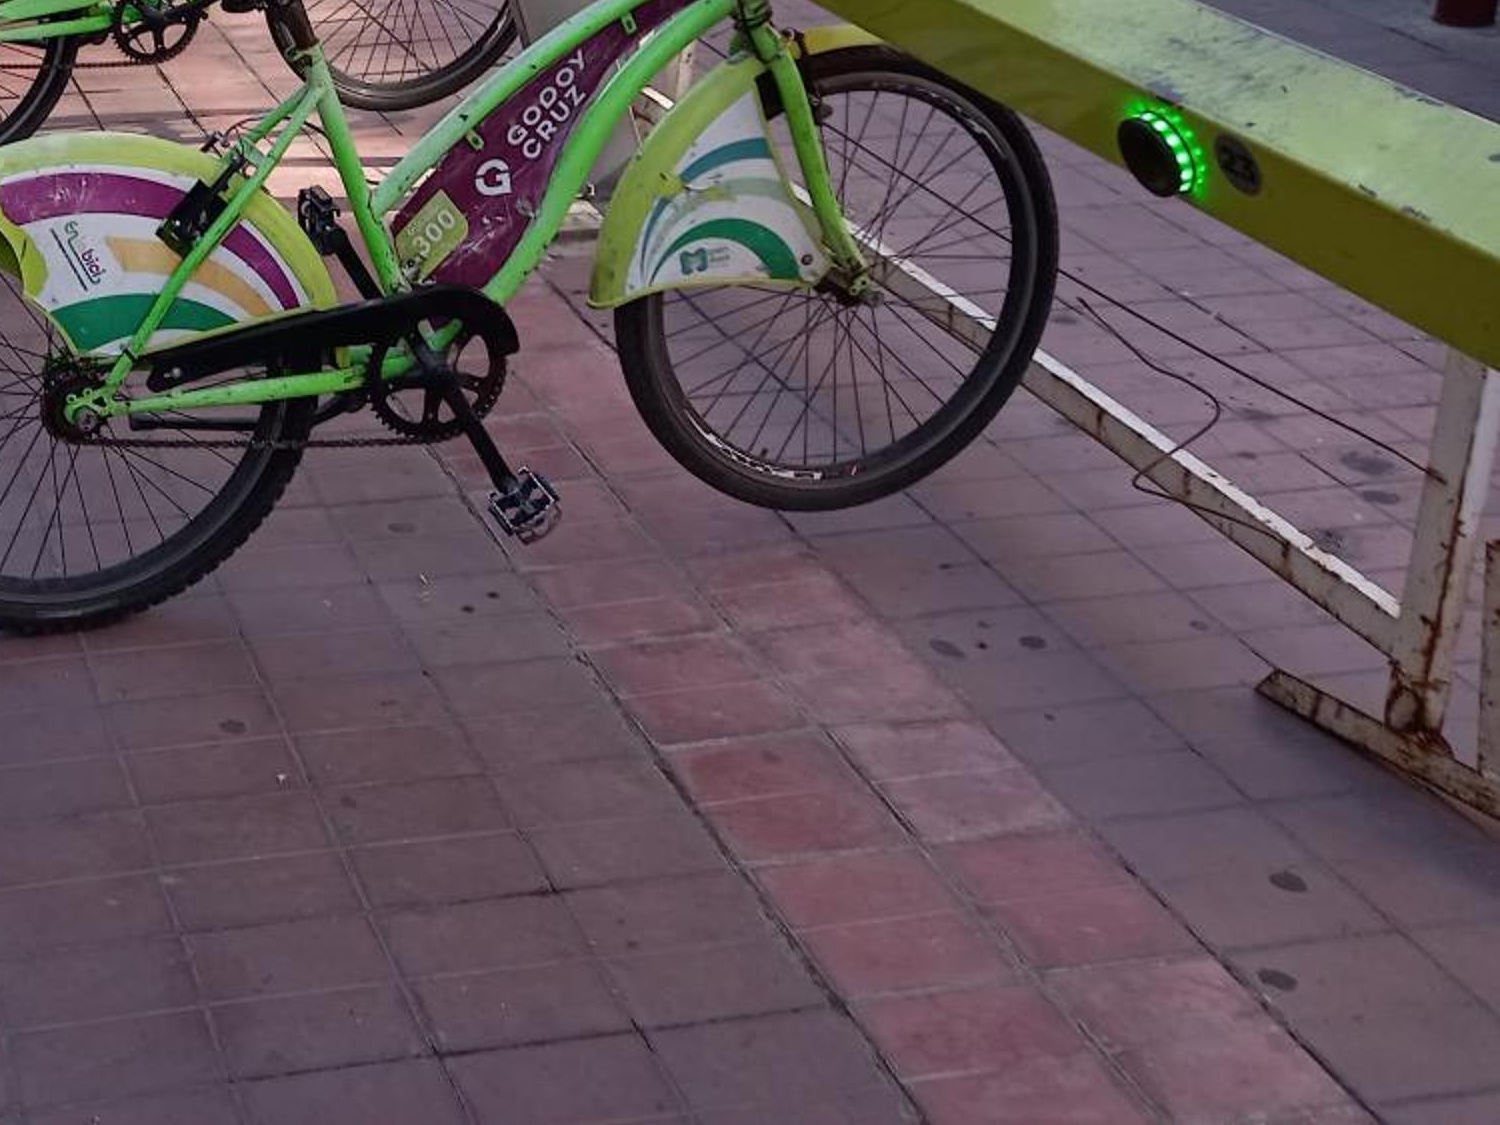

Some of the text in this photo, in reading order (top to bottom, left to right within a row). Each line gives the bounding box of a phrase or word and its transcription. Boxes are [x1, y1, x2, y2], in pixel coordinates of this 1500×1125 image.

[507, 48, 586, 146] GODOY
[523, 84, 587, 159] CRUZ
[412, 209, 457, 255] 300
